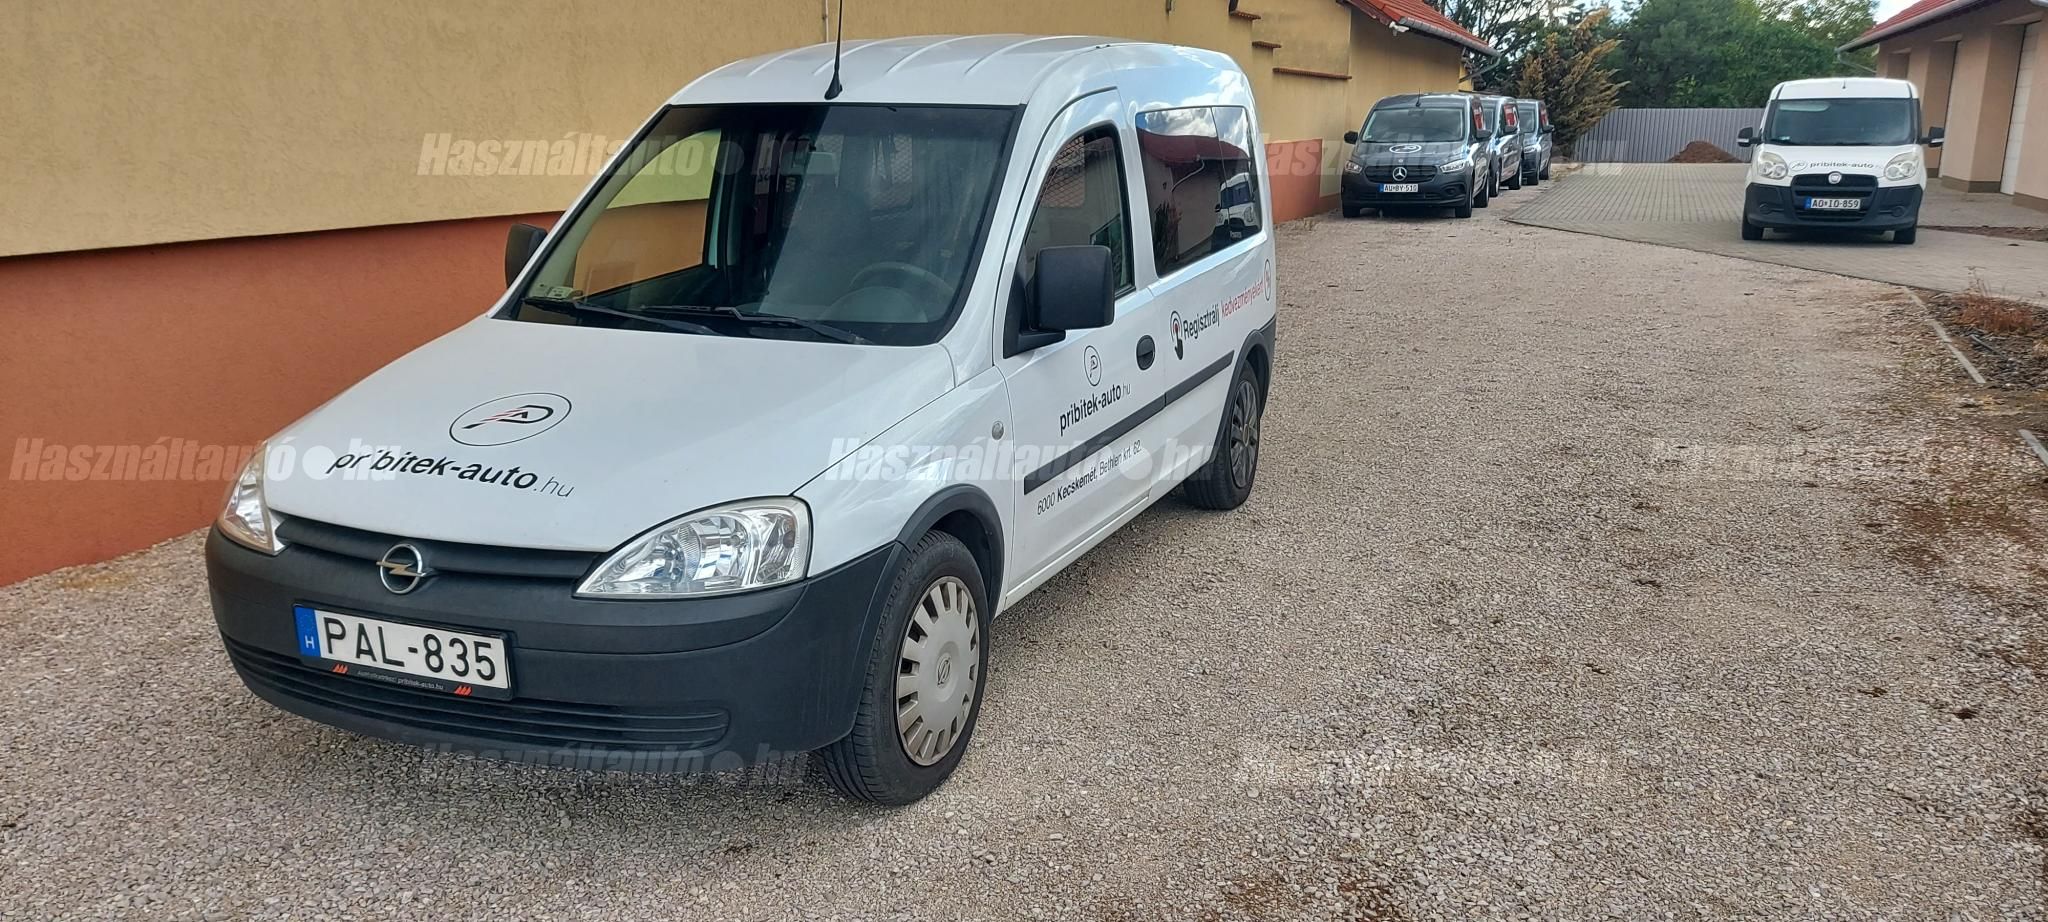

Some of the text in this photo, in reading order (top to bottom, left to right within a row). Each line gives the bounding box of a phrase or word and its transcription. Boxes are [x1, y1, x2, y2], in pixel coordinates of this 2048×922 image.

[1183, 303, 1220, 341] Regisztrálj
[325, 449, 575, 498] pribitek-auto.hu
[1037, 491, 1056, 516] 6000
[1057, 465, 1098, 503] Kecskemét,
[304, 635, 315, 649] H
[323, 616, 496, 681] PAL-835
